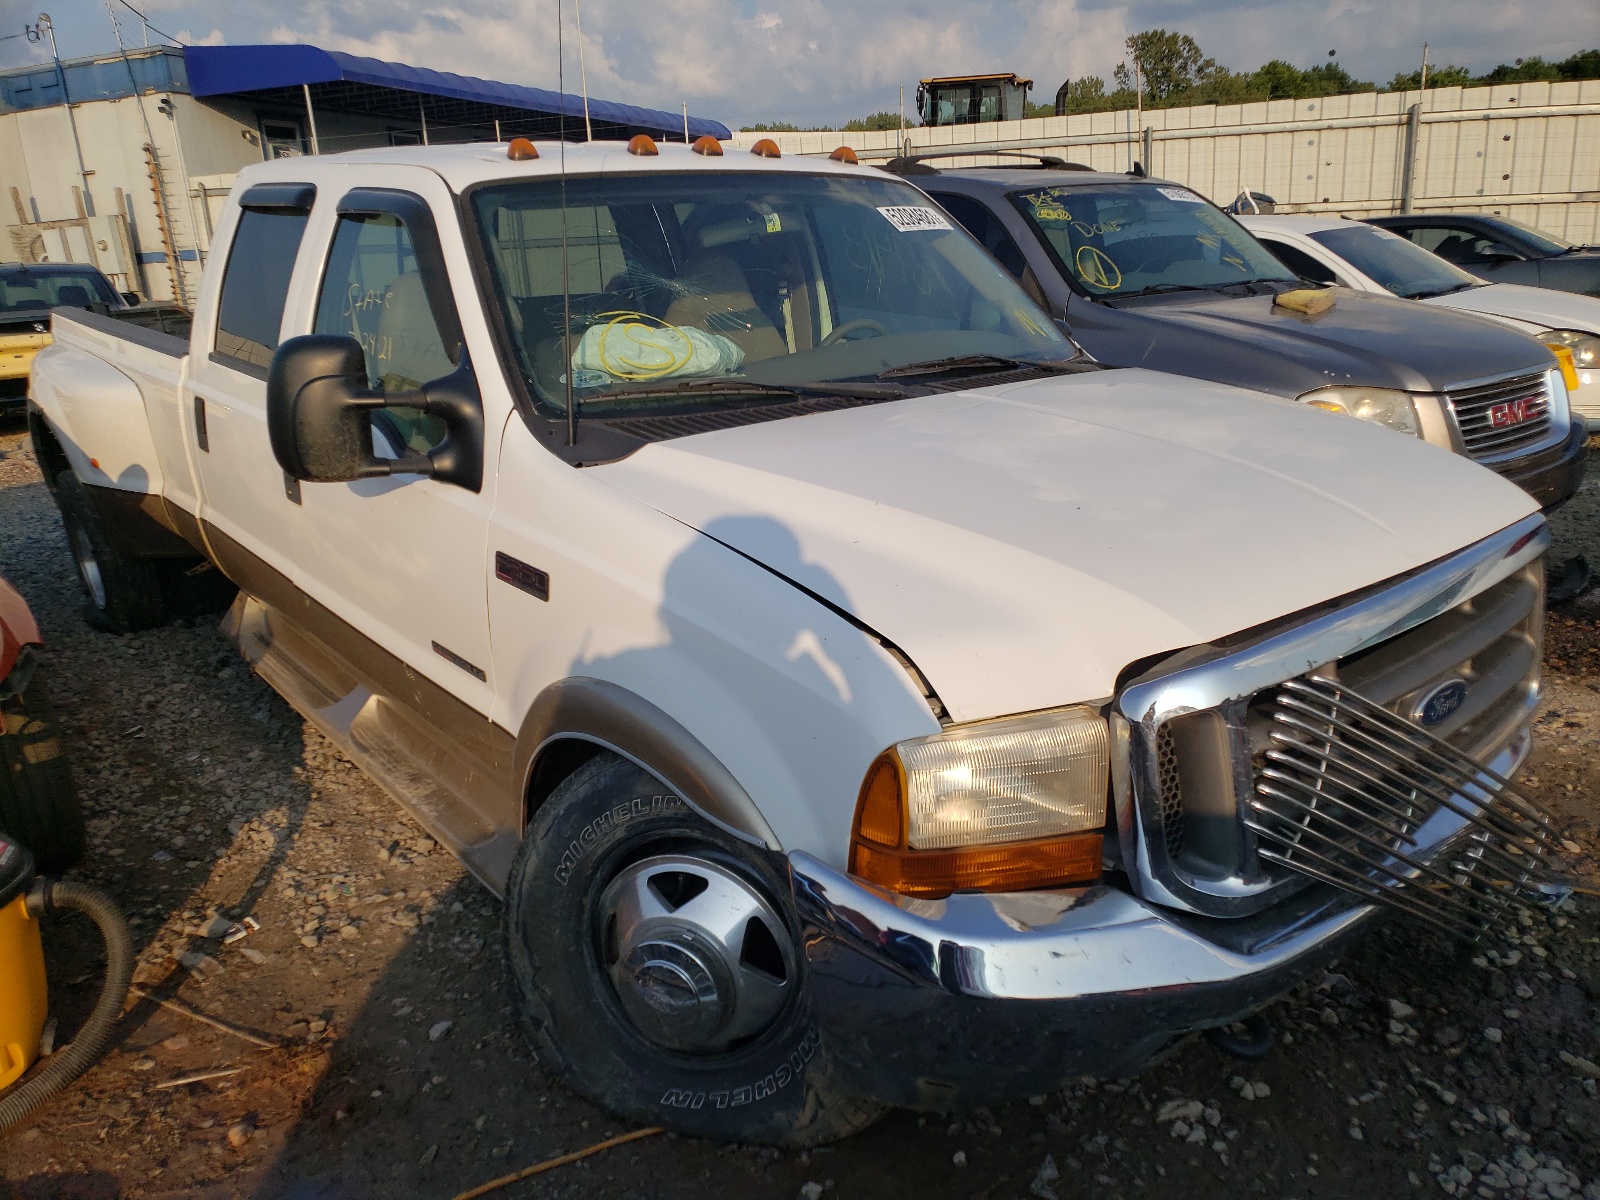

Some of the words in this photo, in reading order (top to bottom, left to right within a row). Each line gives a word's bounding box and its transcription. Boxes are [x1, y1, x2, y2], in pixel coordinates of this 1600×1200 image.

[1489, 397, 1540, 428] GMC
[554, 795, 687, 886] MICHELIN
[659, 1024, 823, 1109] MICHELIN
